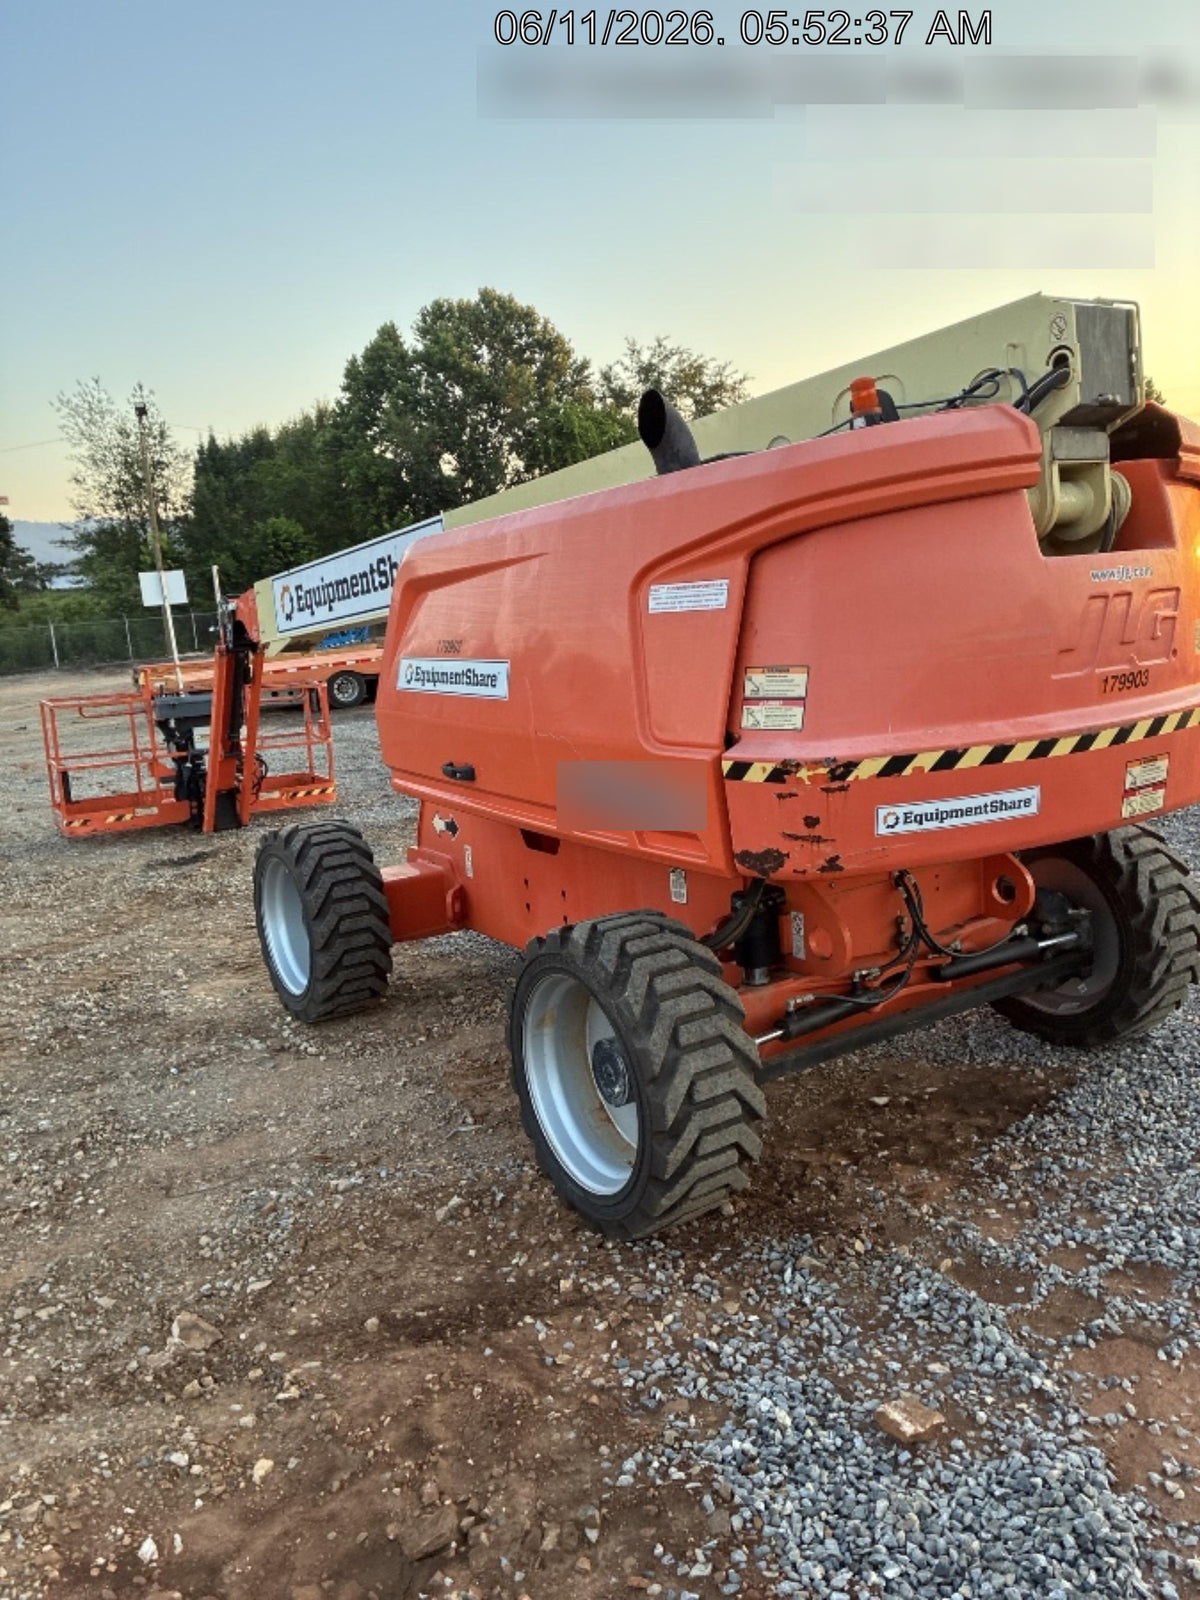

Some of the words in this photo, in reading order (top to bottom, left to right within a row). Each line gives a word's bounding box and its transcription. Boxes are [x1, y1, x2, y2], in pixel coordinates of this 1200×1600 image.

[1051, 586, 1181, 679] JLG
[415, 666, 498, 688] EquipmentShare
[1101, 668, 1150, 693] 179903
[902, 797, 1032, 826] EquipmentShare
